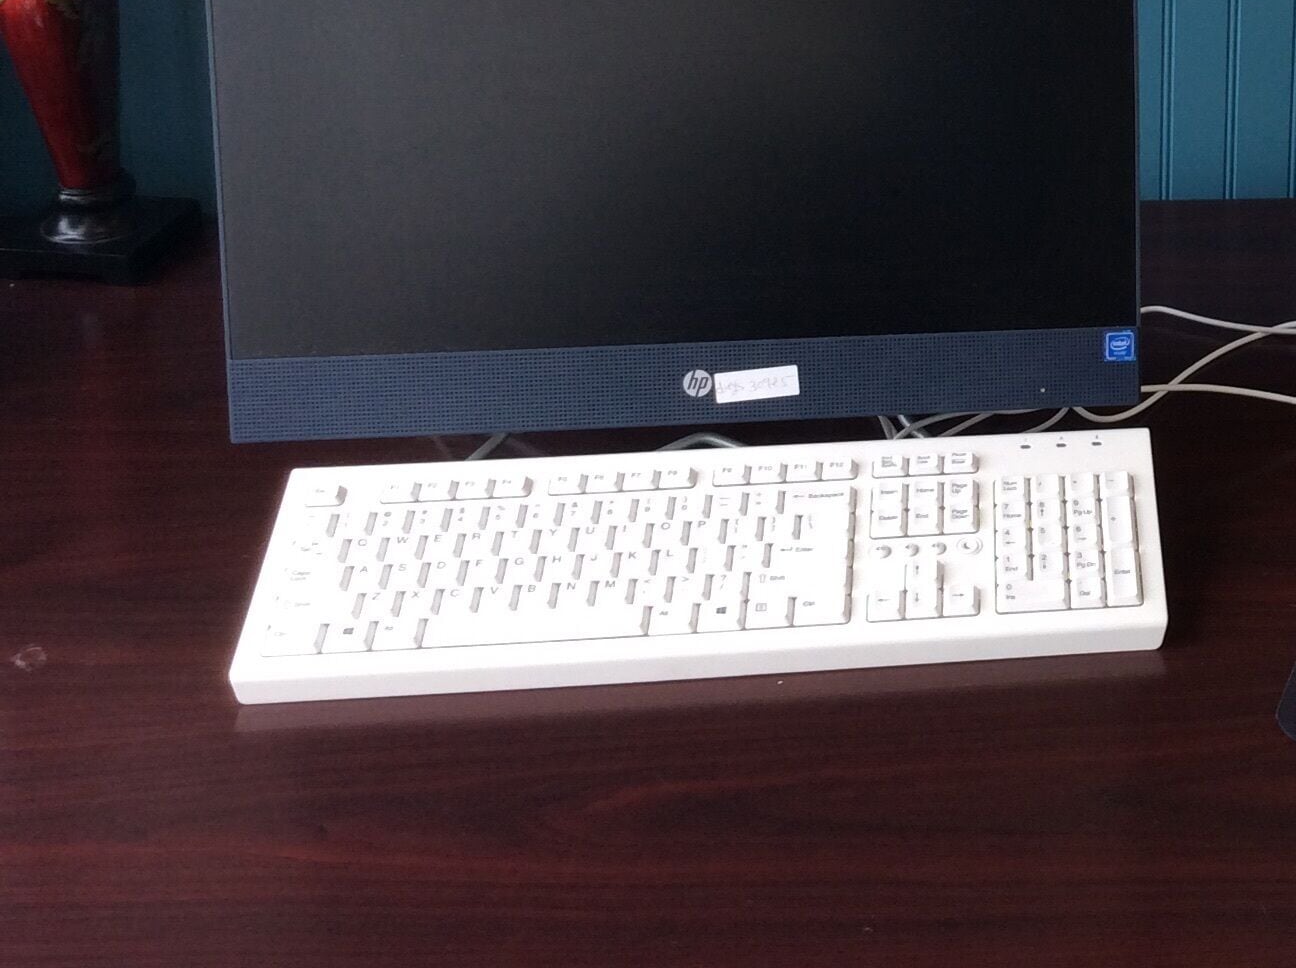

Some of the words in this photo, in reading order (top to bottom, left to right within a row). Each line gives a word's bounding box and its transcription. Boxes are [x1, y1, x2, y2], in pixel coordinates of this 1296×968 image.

[687, 370, 709, 397] hp
[585, 526, 595, 534] U
[660, 522, 671, 530] O
[471, 532, 481, 540] R
[511, 530, 520, 538] T
[548, 528, 558, 536] Y
[396, 536, 409, 544] W
[433, 534, 442, 543] E
[551, 555, 562, 563] H
[628, 551, 638, 559] K
[475, 559, 484, 567] F
[514, 557, 524, 565] G
[397, 563, 408, 571] S
[436, 561, 446, 570] D
[359, 566, 368, 574] A
[566, 582, 576, 590] N
[604, 580, 616, 588] M
[449, 589, 460, 597] C
[490, 587, 499, 595] V
[527, 585, 537, 593] B
[371, 592, 381, 600] Z
[410, 591, 420, 599] X
